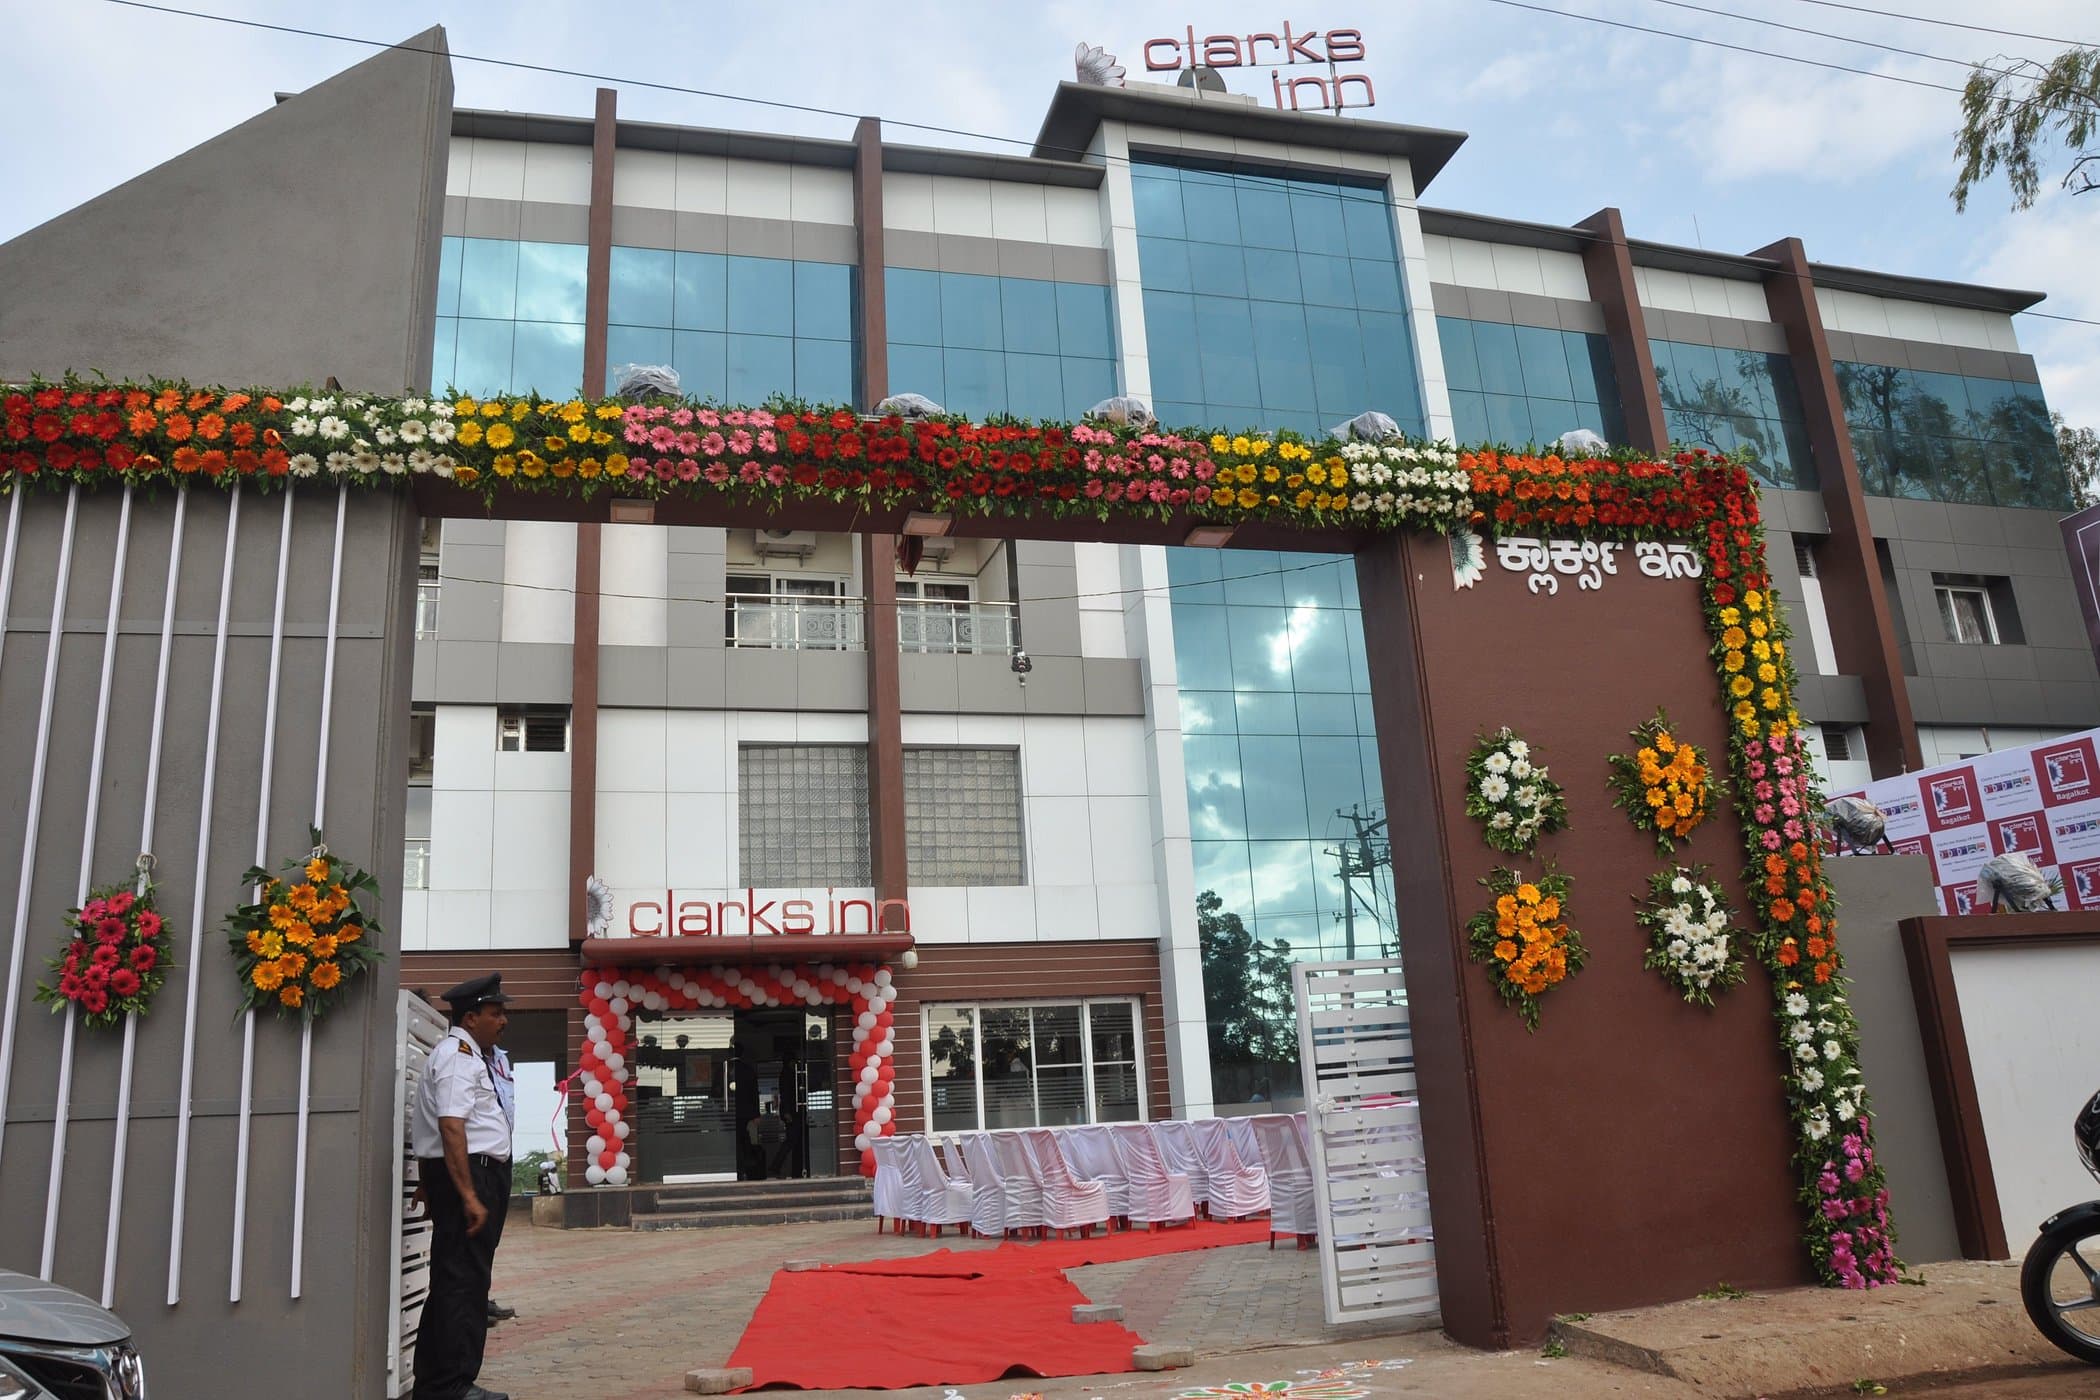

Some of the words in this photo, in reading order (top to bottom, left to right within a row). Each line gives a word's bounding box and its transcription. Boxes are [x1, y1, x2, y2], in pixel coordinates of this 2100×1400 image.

[1144, 21, 1365, 71] clarks
[1272, 70, 1375, 111] inn
[2056, 789, 2089, 800] Bagalkot
[1941, 814, 1970, 825] Bagalkot
[629, 887, 815, 937] clarks
[828, 886, 911, 934] inn
